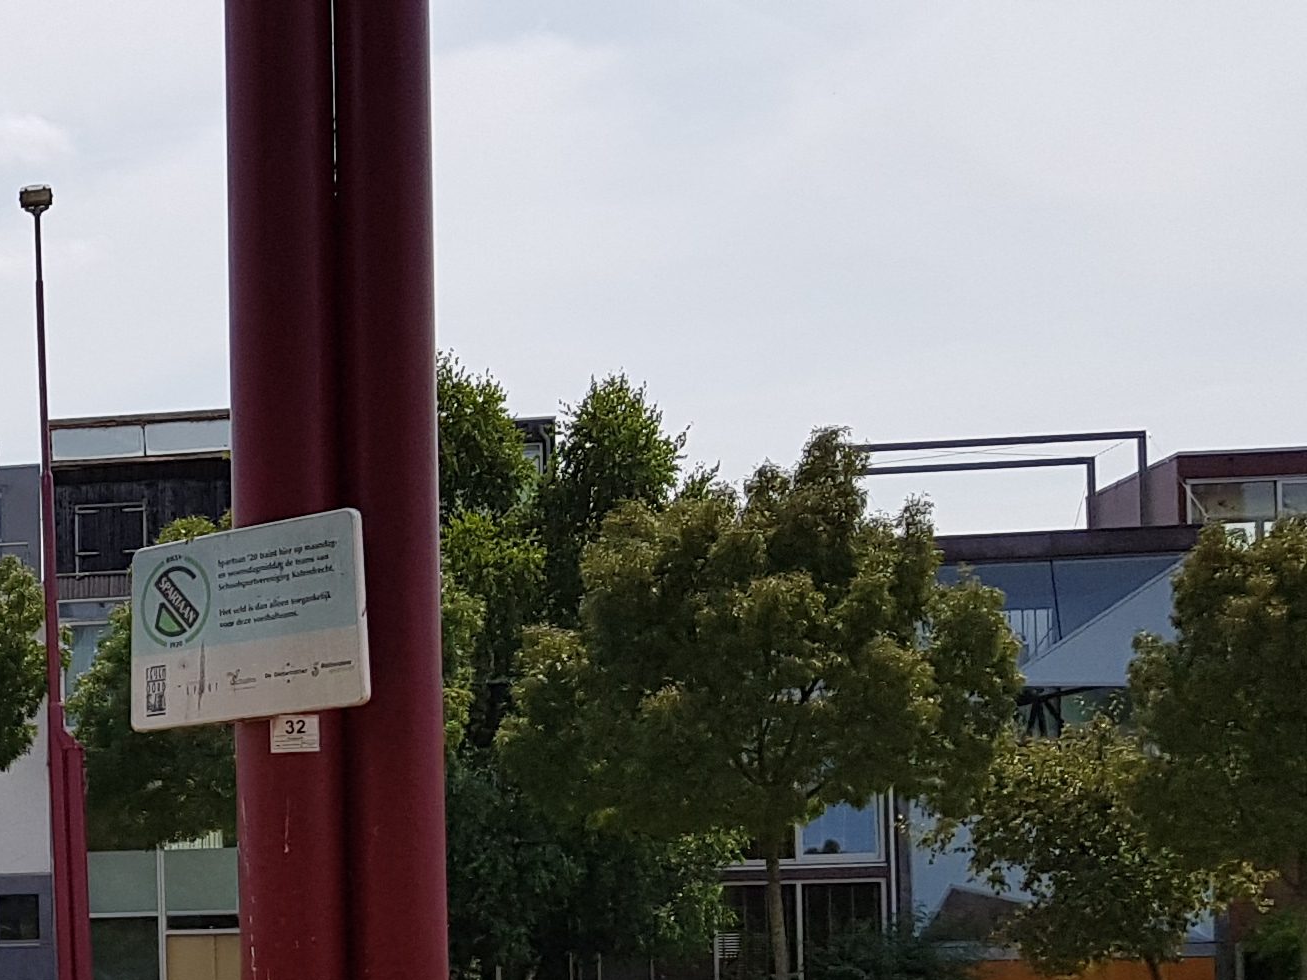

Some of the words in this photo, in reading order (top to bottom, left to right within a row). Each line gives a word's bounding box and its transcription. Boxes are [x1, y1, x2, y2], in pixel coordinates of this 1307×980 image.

[158, 576, 196, 623] SPARTAAN
[219, 608, 231, 616] Het
[285, 719, 306, 735] 32
